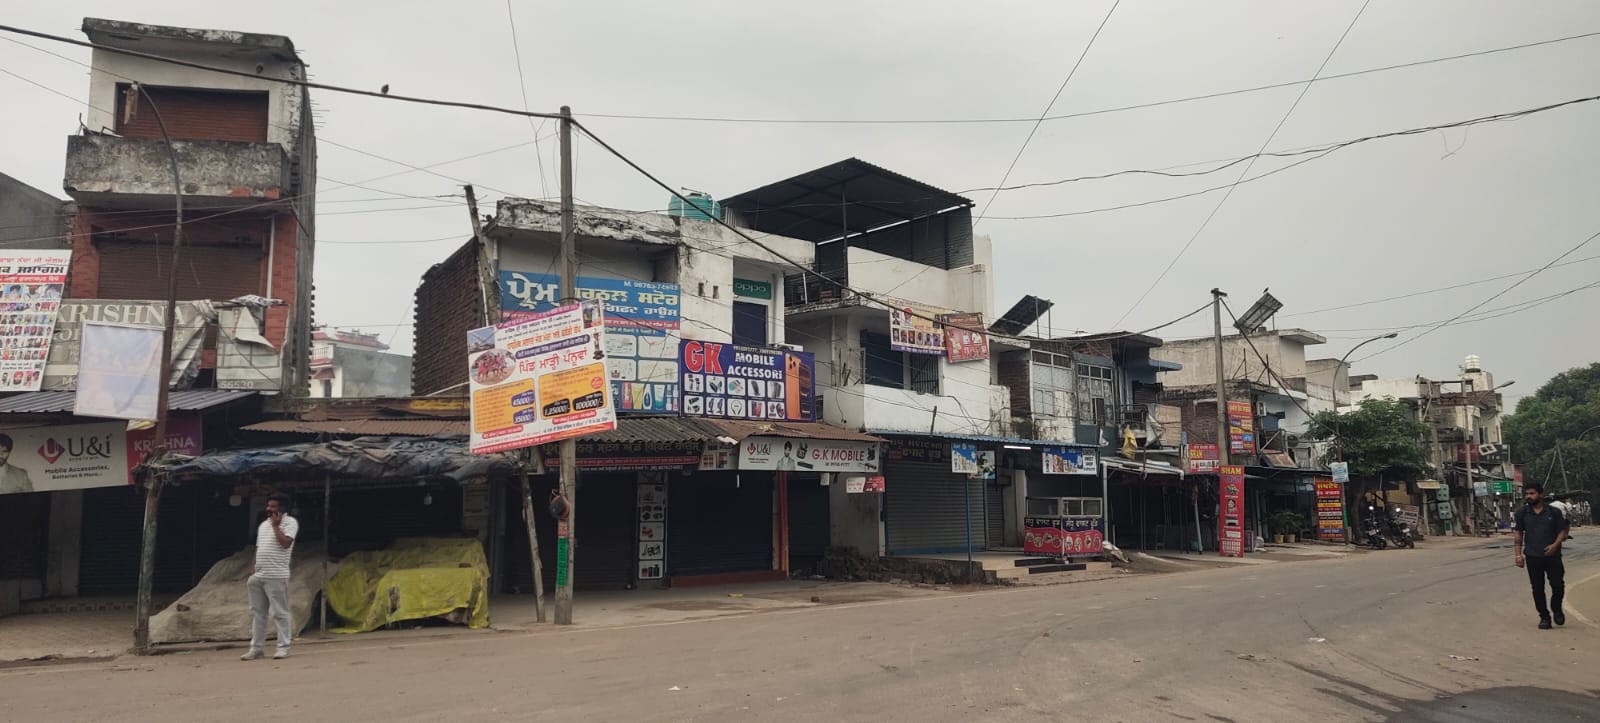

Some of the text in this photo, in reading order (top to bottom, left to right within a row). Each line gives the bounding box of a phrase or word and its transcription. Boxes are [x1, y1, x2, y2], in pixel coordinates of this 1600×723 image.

[735, 283, 767, 293] oppo
[637, 289, 678, 306] ਸਟੋਰ
[684, 340, 724, 375] GK
[735, 352, 775, 366] MOBILE
[134, 437, 194, 452] KRIHNA
[830, 449, 865, 462] MOBILE
[1221, 467, 1242, 475] SHAM
